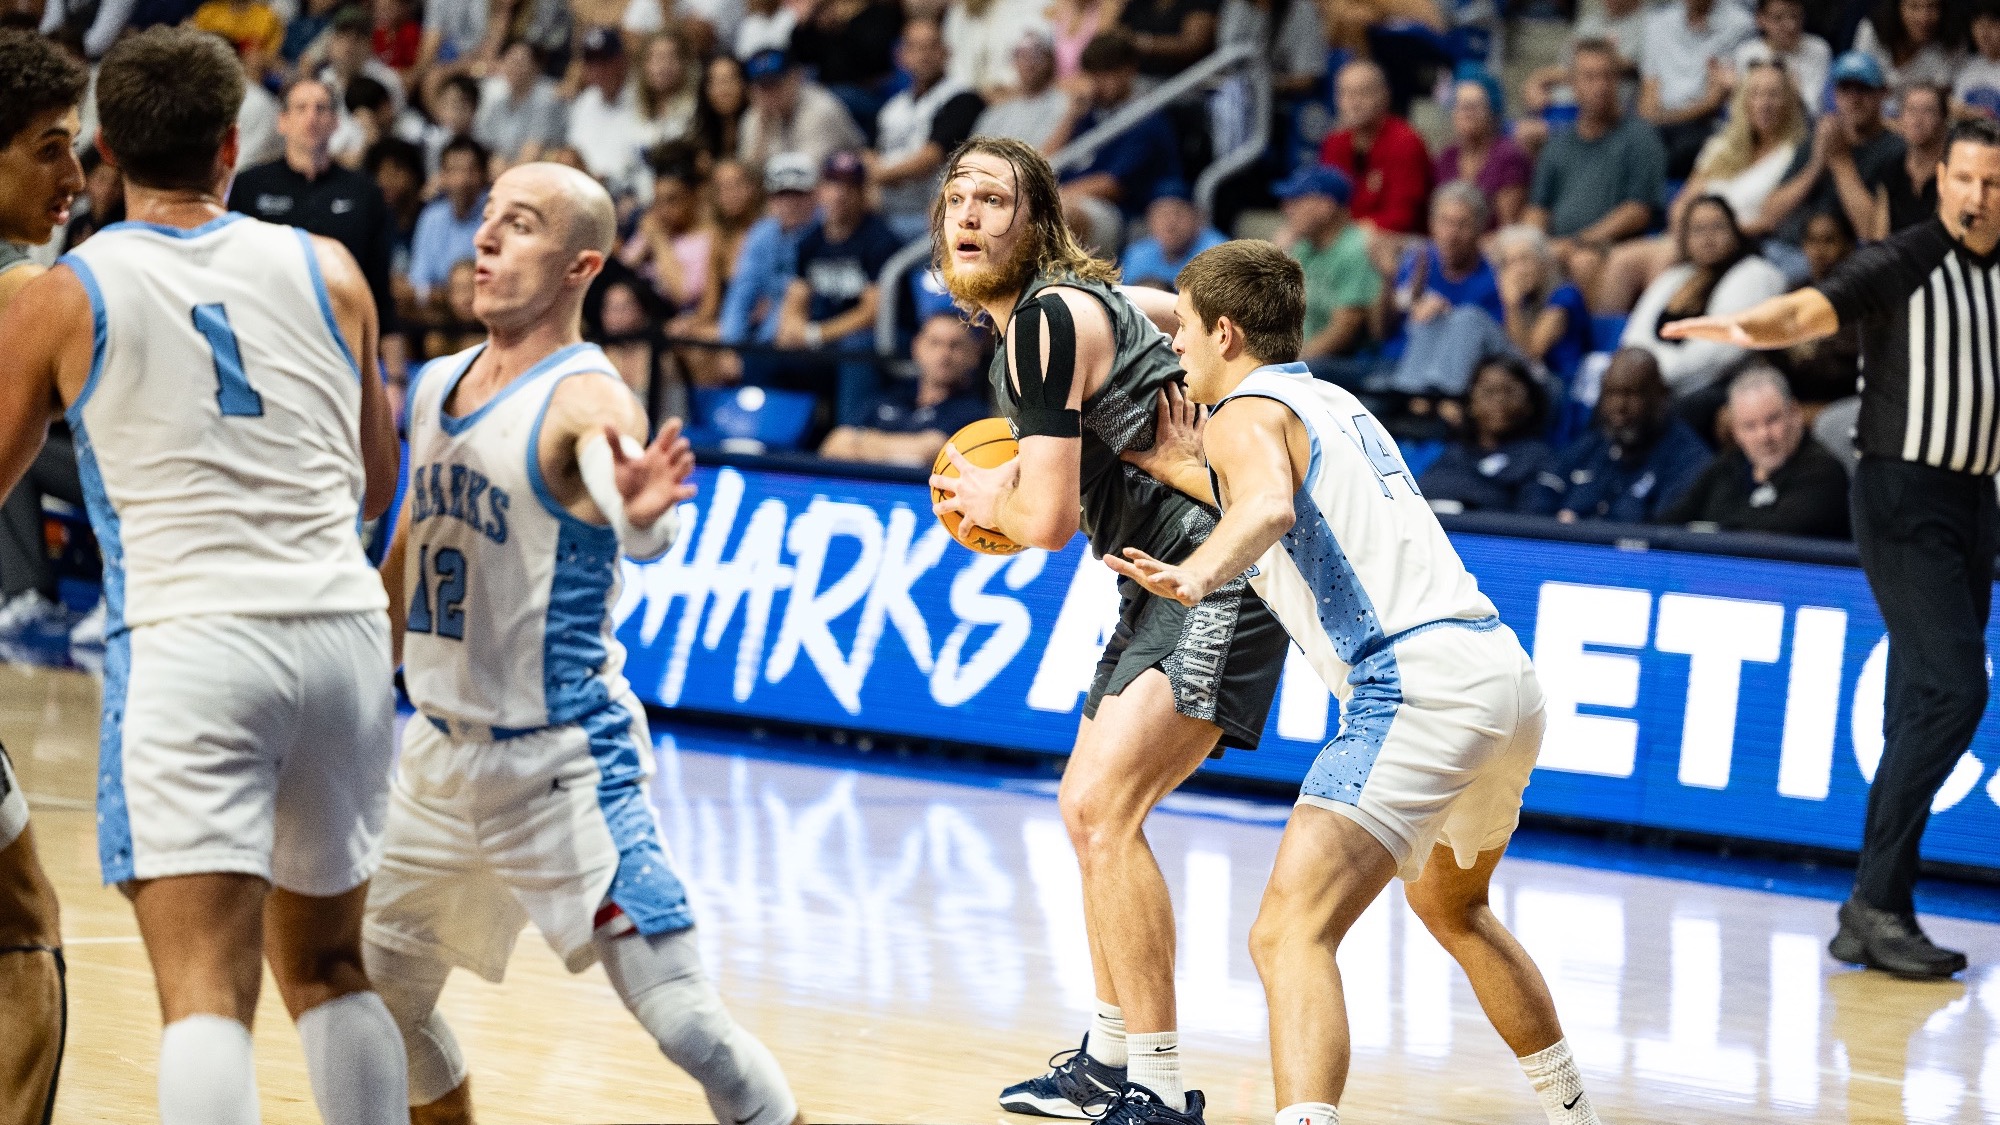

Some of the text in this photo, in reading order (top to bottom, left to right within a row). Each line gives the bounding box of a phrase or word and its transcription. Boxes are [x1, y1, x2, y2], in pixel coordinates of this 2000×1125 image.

[191, 301, 264, 418] 1
[407, 543, 467, 641] 12
[1180, 606, 1233, 707] SAILFISH
